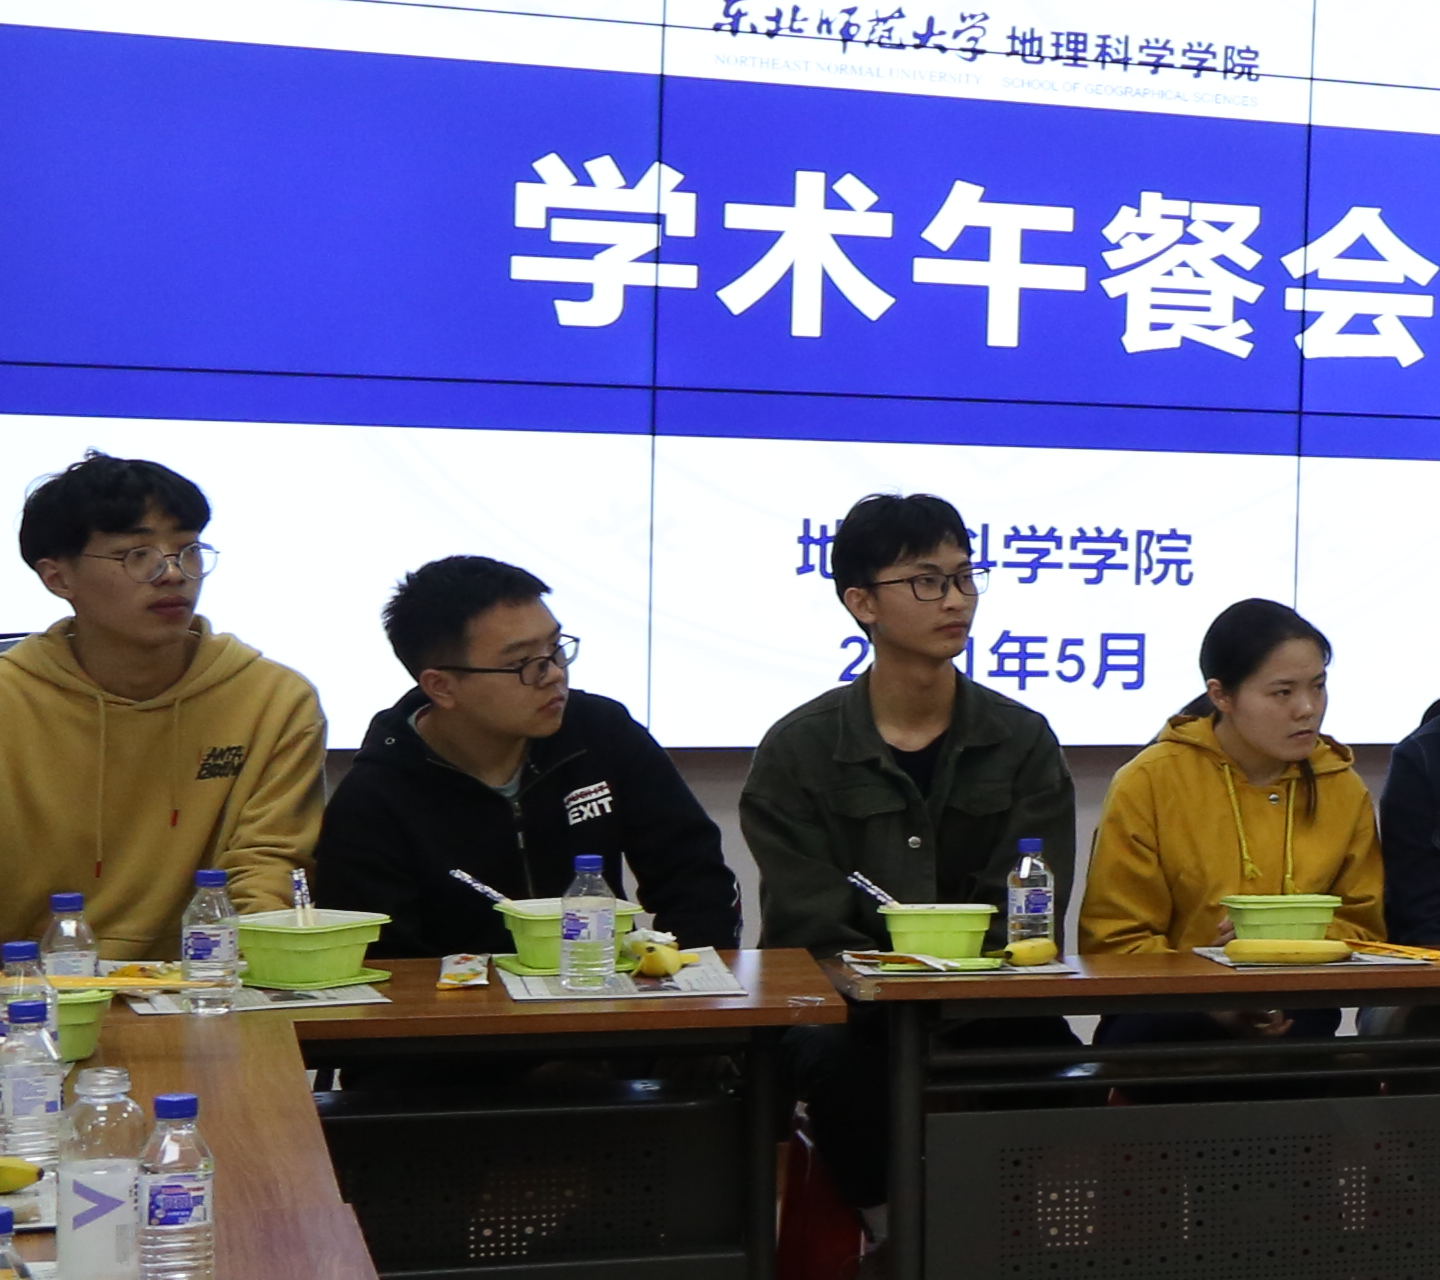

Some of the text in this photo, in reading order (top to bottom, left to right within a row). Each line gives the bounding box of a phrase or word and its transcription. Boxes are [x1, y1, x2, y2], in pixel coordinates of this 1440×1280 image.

[714, 52, 984, 88] NORTHEAST NORMAL UNIVERSITY
[1005, 25, 1261, 84] 地理科学学院
[510, 151, 1440, 369] 学术午餐会
[568, 796, 614, 826] EXIT
